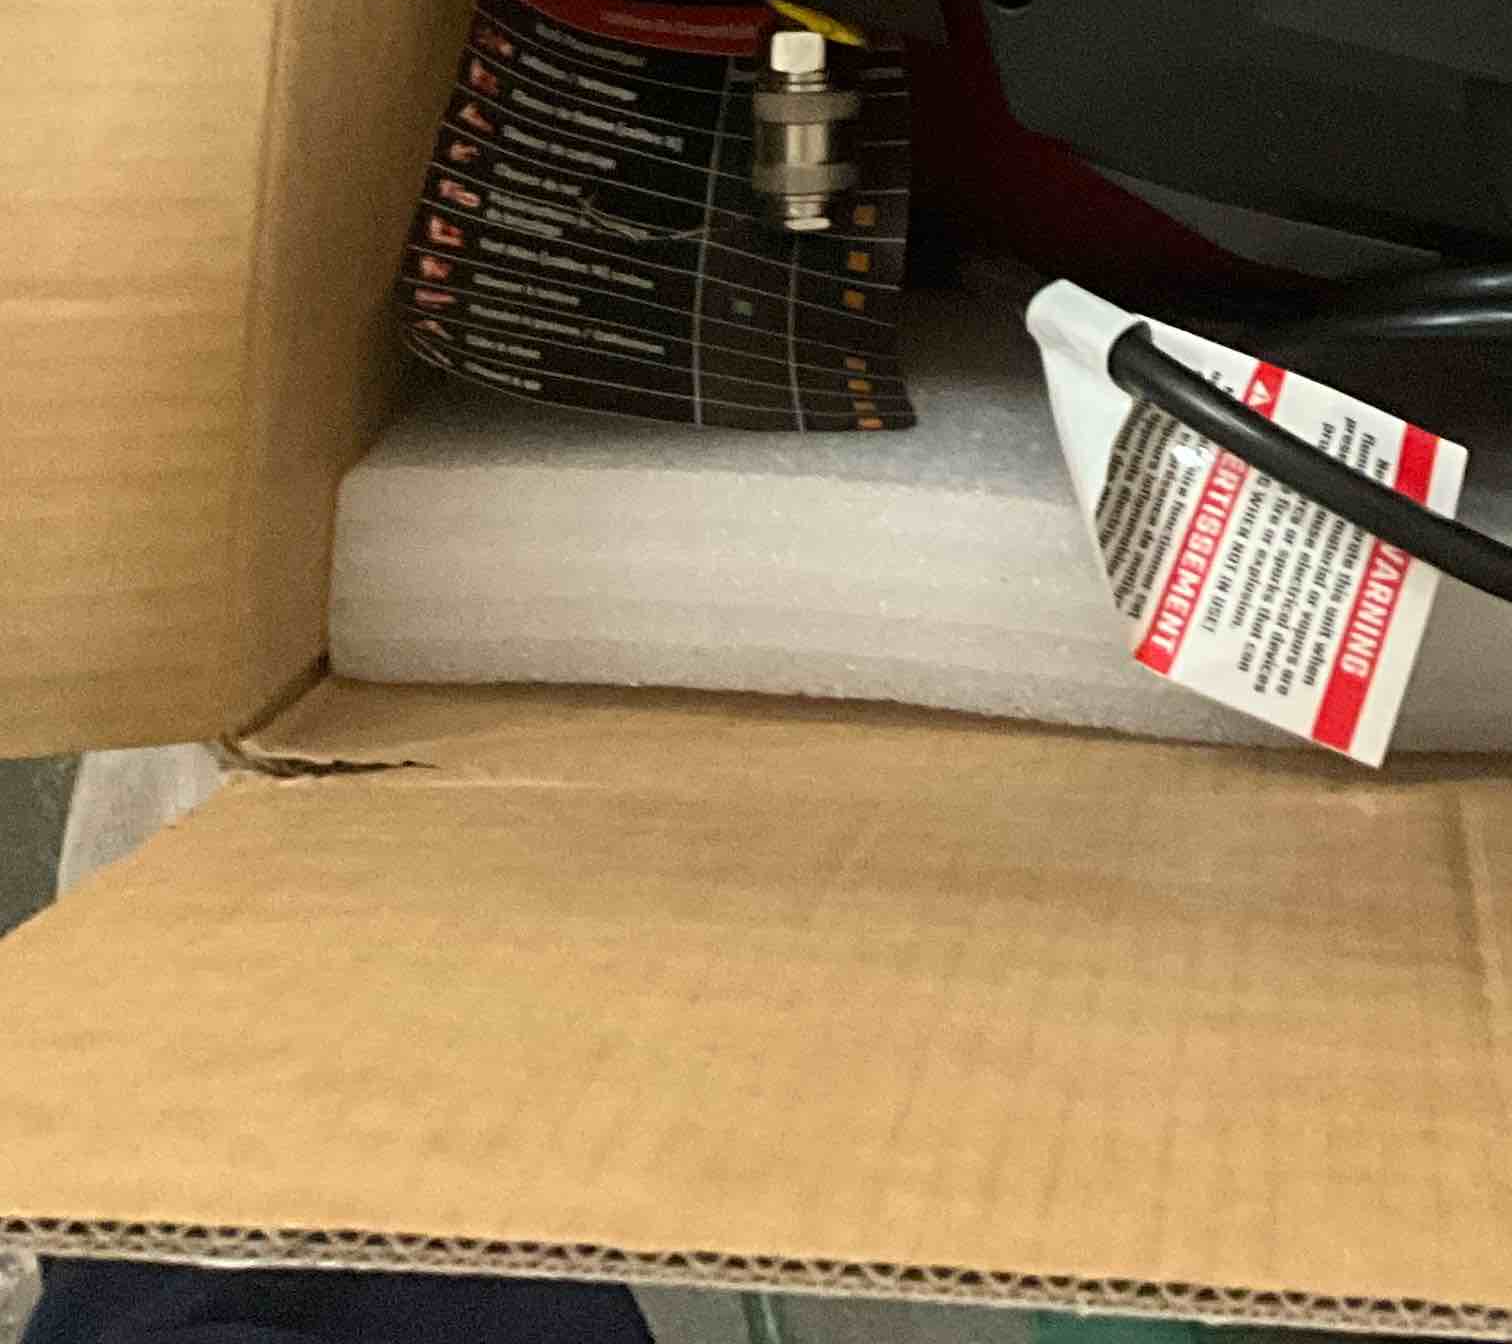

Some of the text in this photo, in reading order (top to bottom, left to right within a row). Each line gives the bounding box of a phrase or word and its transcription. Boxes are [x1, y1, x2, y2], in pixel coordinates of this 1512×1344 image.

[1236, 489, 1265, 540] WHEN
[1269, 496, 1290, 527] fire
[1261, 527, 1277, 546] or
[1283, 528, 1300, 547] or
[1223, 540, 1246, 574] NOT
[1216, 574, 1234, 594] IN
[1262, 547, 1293, 605] sparks
[1276, 551, 1315, 630] electrical
[1331, 572, 1354, 605] this
[1200, 594, 1227, 634] USE!
[1307, 589, 1322, 608] or
[1250, 606, 1273, 641] that
[1281, 610, 1315, 667] vapors
[1319, 606, 1342, 641] unit
[1238, 642, 1259, 674] can
[1253, 631, 1286, 696] devices
[1302, 641, 1330, 688] when
[1276, 668, 1295, 697] are
